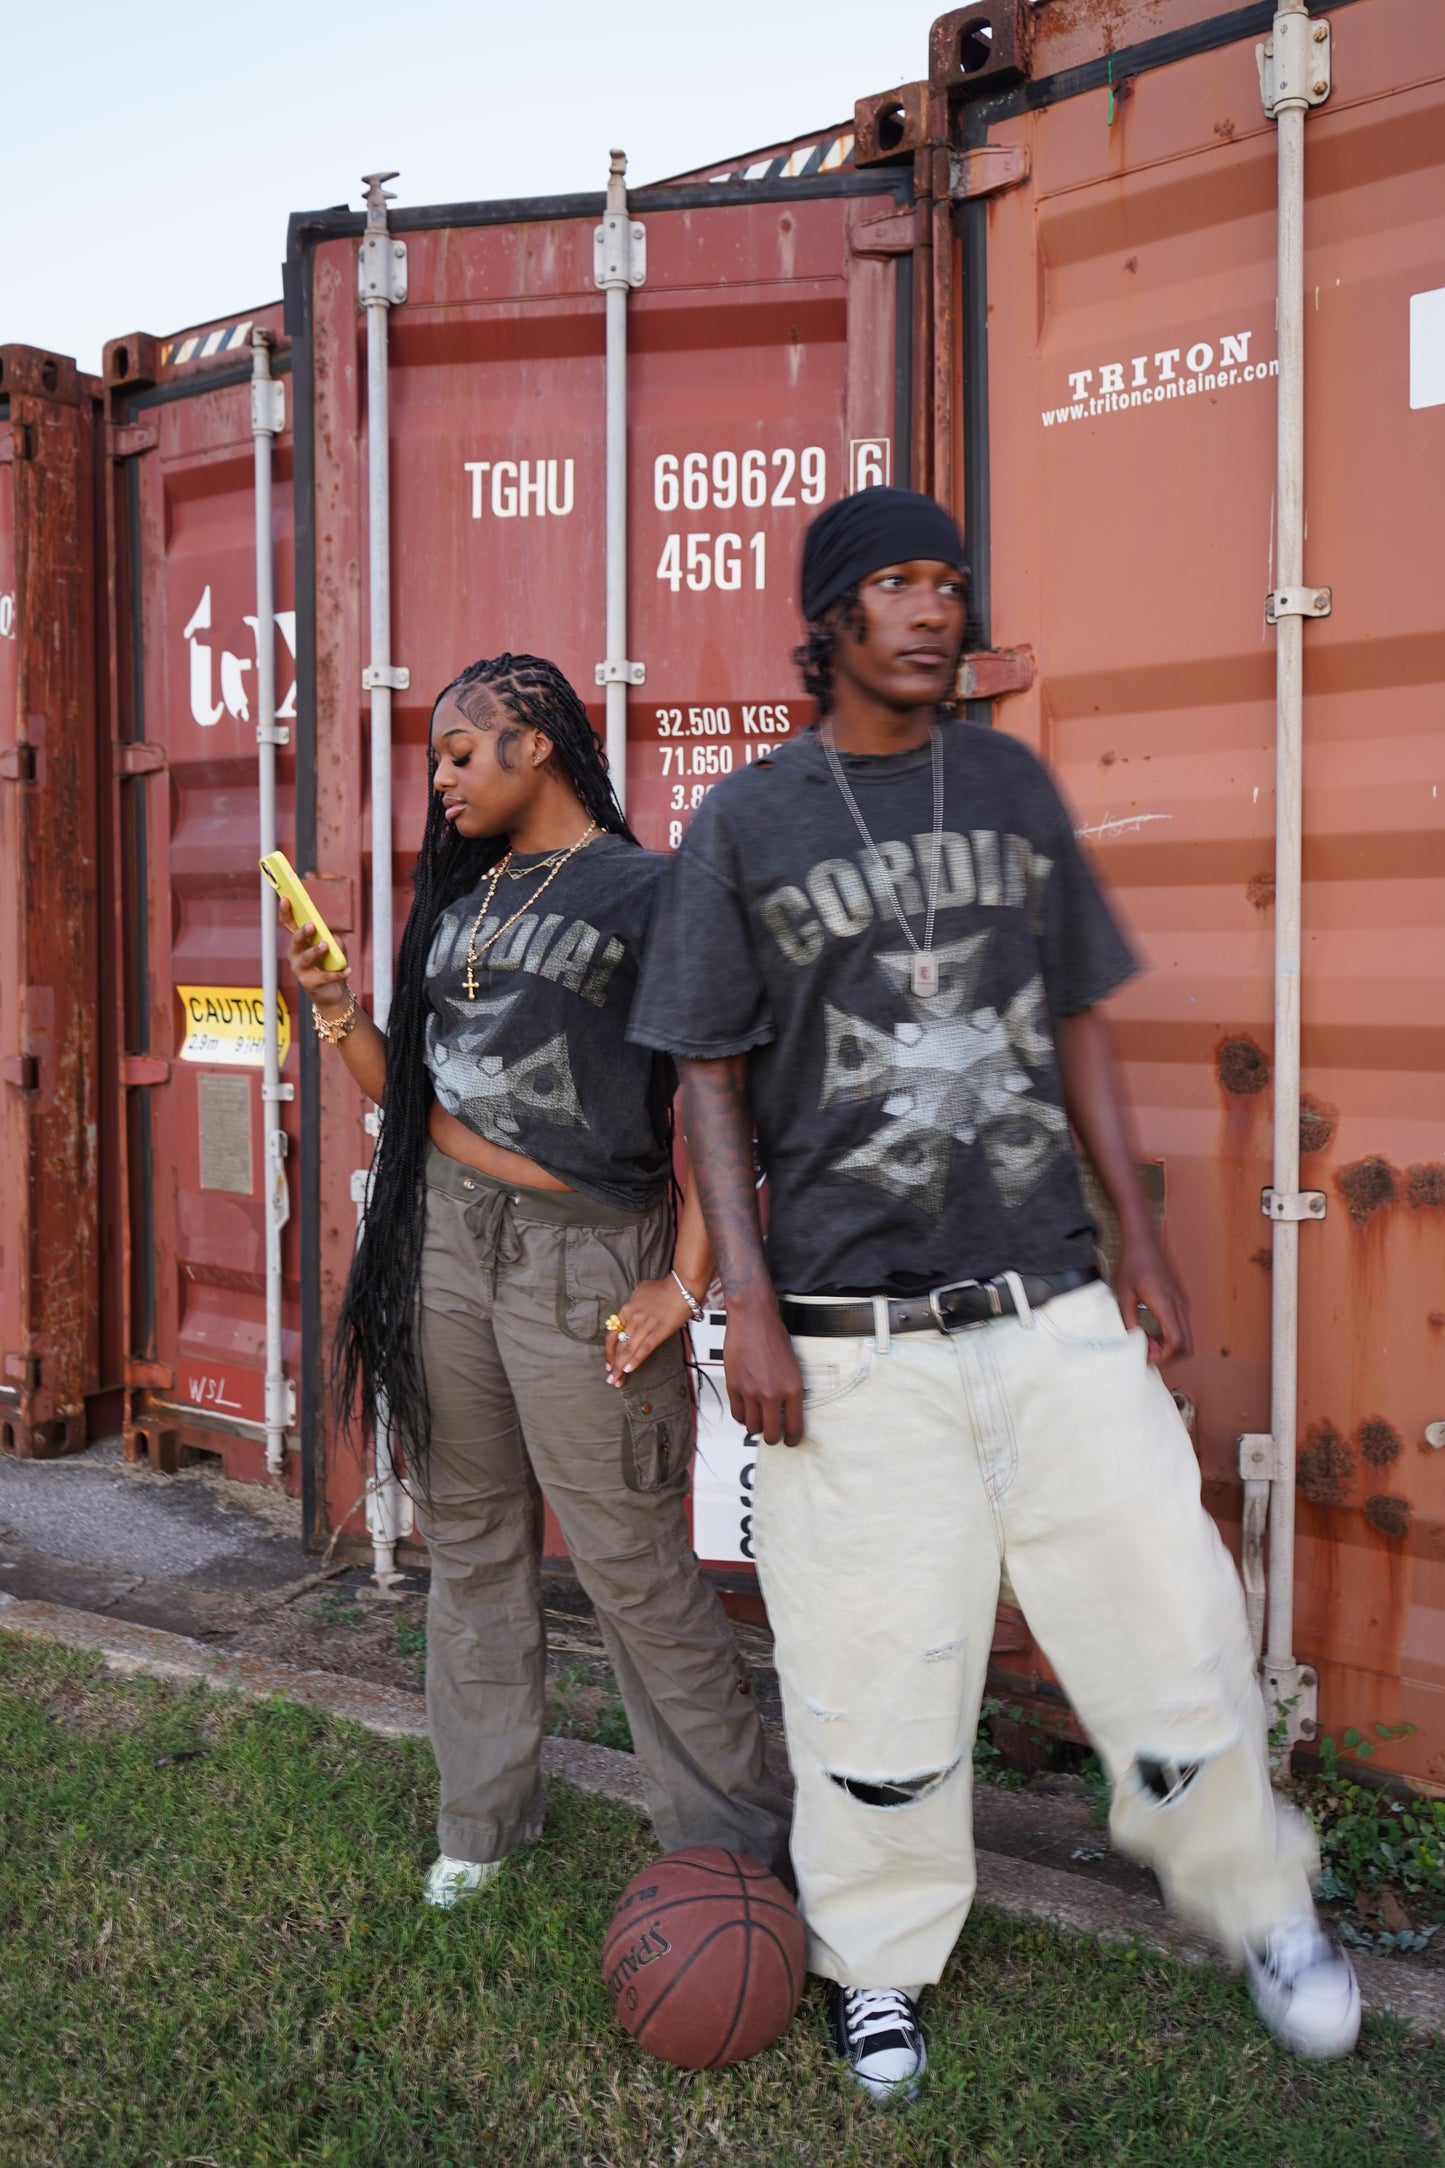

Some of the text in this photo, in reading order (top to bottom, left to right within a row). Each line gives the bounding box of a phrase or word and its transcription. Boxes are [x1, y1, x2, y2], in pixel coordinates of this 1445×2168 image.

[1069, 331, 1252, 401] TRITON
[464, 443, 882, 519] TGHU 669629 6
[657, 531, 767, 592] 45G1
[656, 705, 790, 737] 32.500 KGS
[659, 745, 733, 776] 71.650
[670, 783, 715, 810] 3.8
